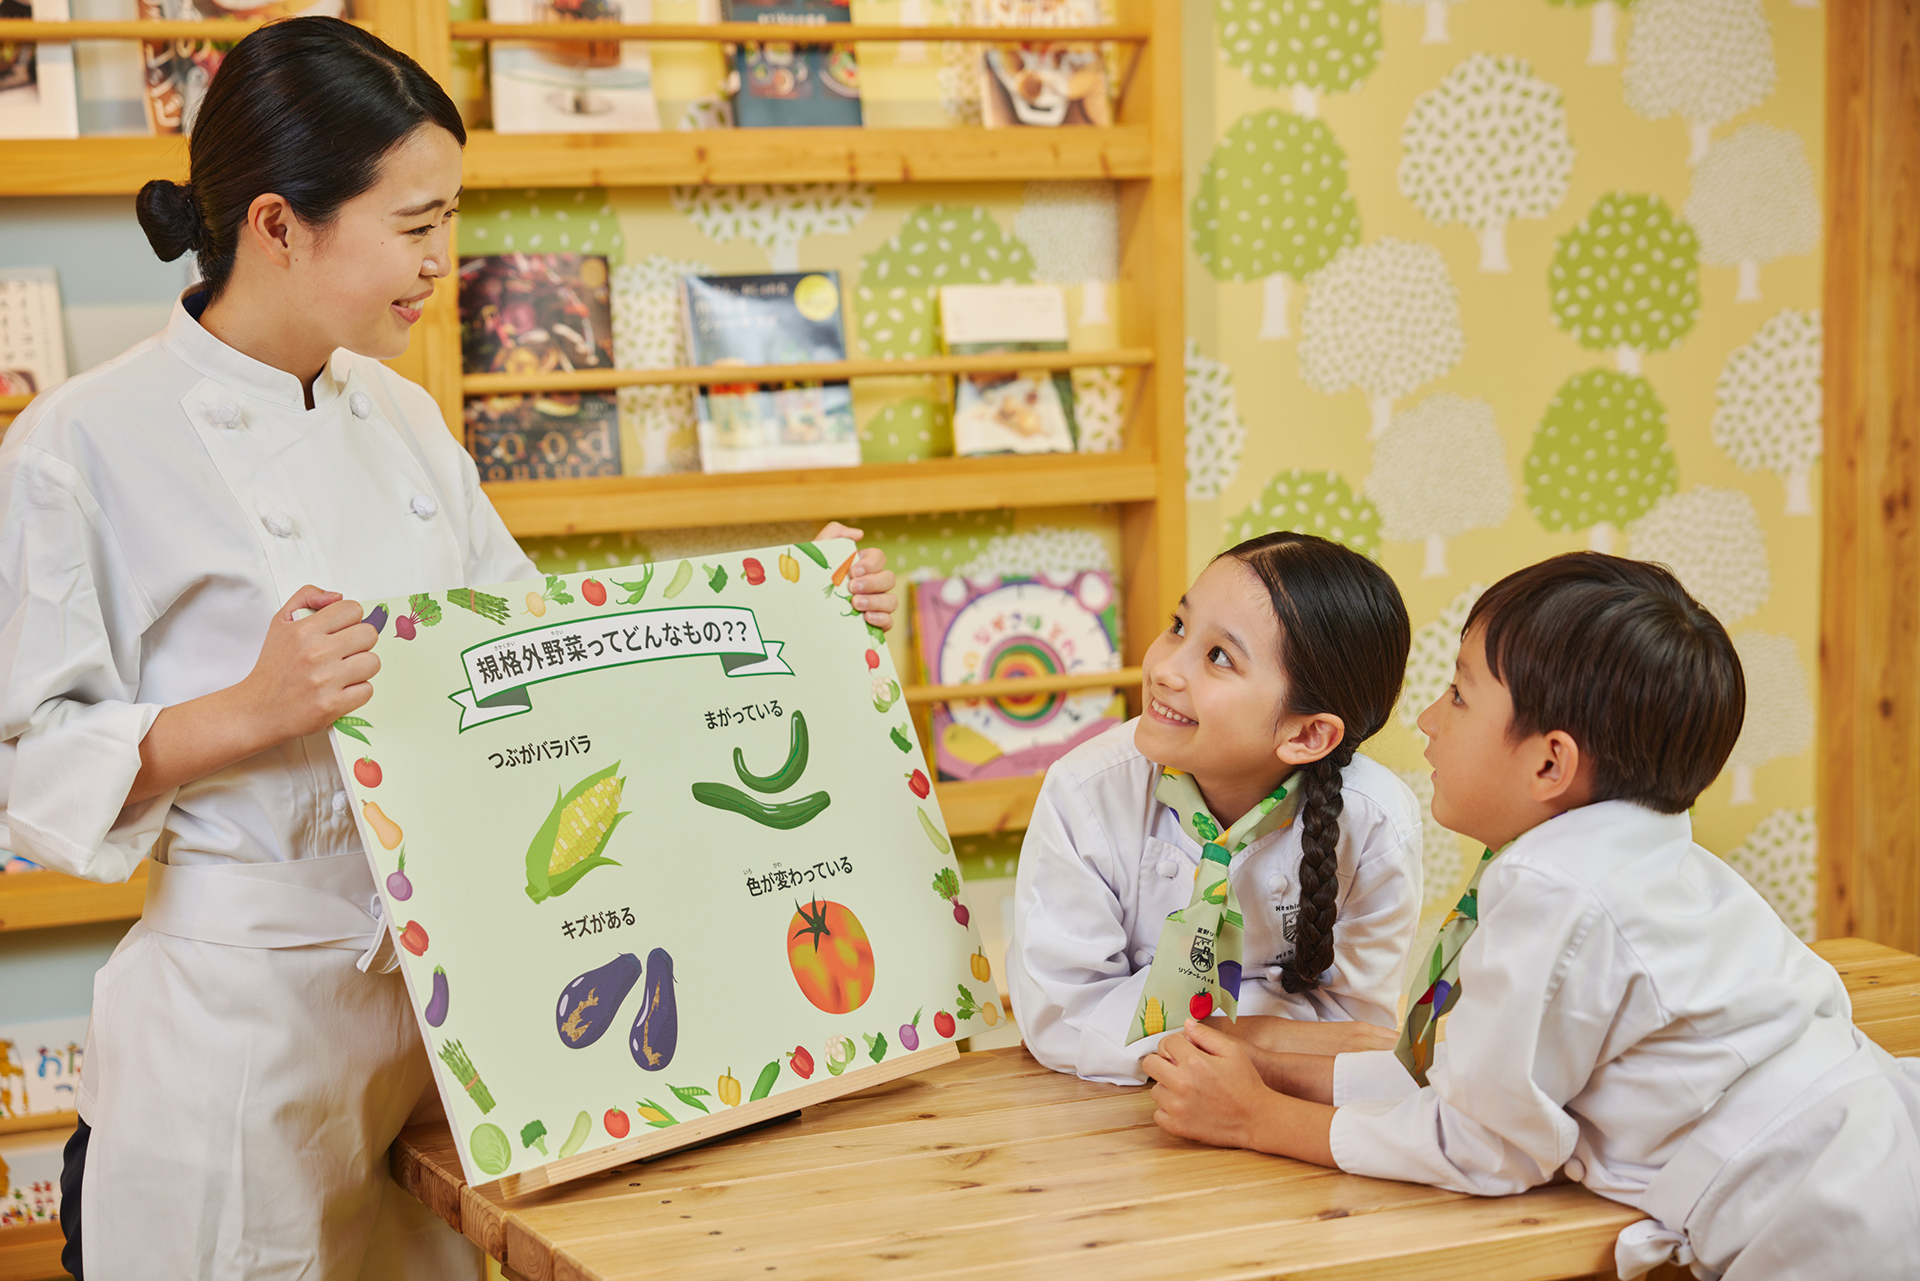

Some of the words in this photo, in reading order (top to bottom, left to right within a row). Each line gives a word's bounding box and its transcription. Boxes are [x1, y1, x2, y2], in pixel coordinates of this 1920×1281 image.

[550, 629, 565, 637] やさい
[703, 699, 784, 730] まがっている
[487, 734, 592, 770] つぶがバラバラ
[745, 855, 854, 897] 色が変わっている
[560, 906, 637, 940] キズがある
